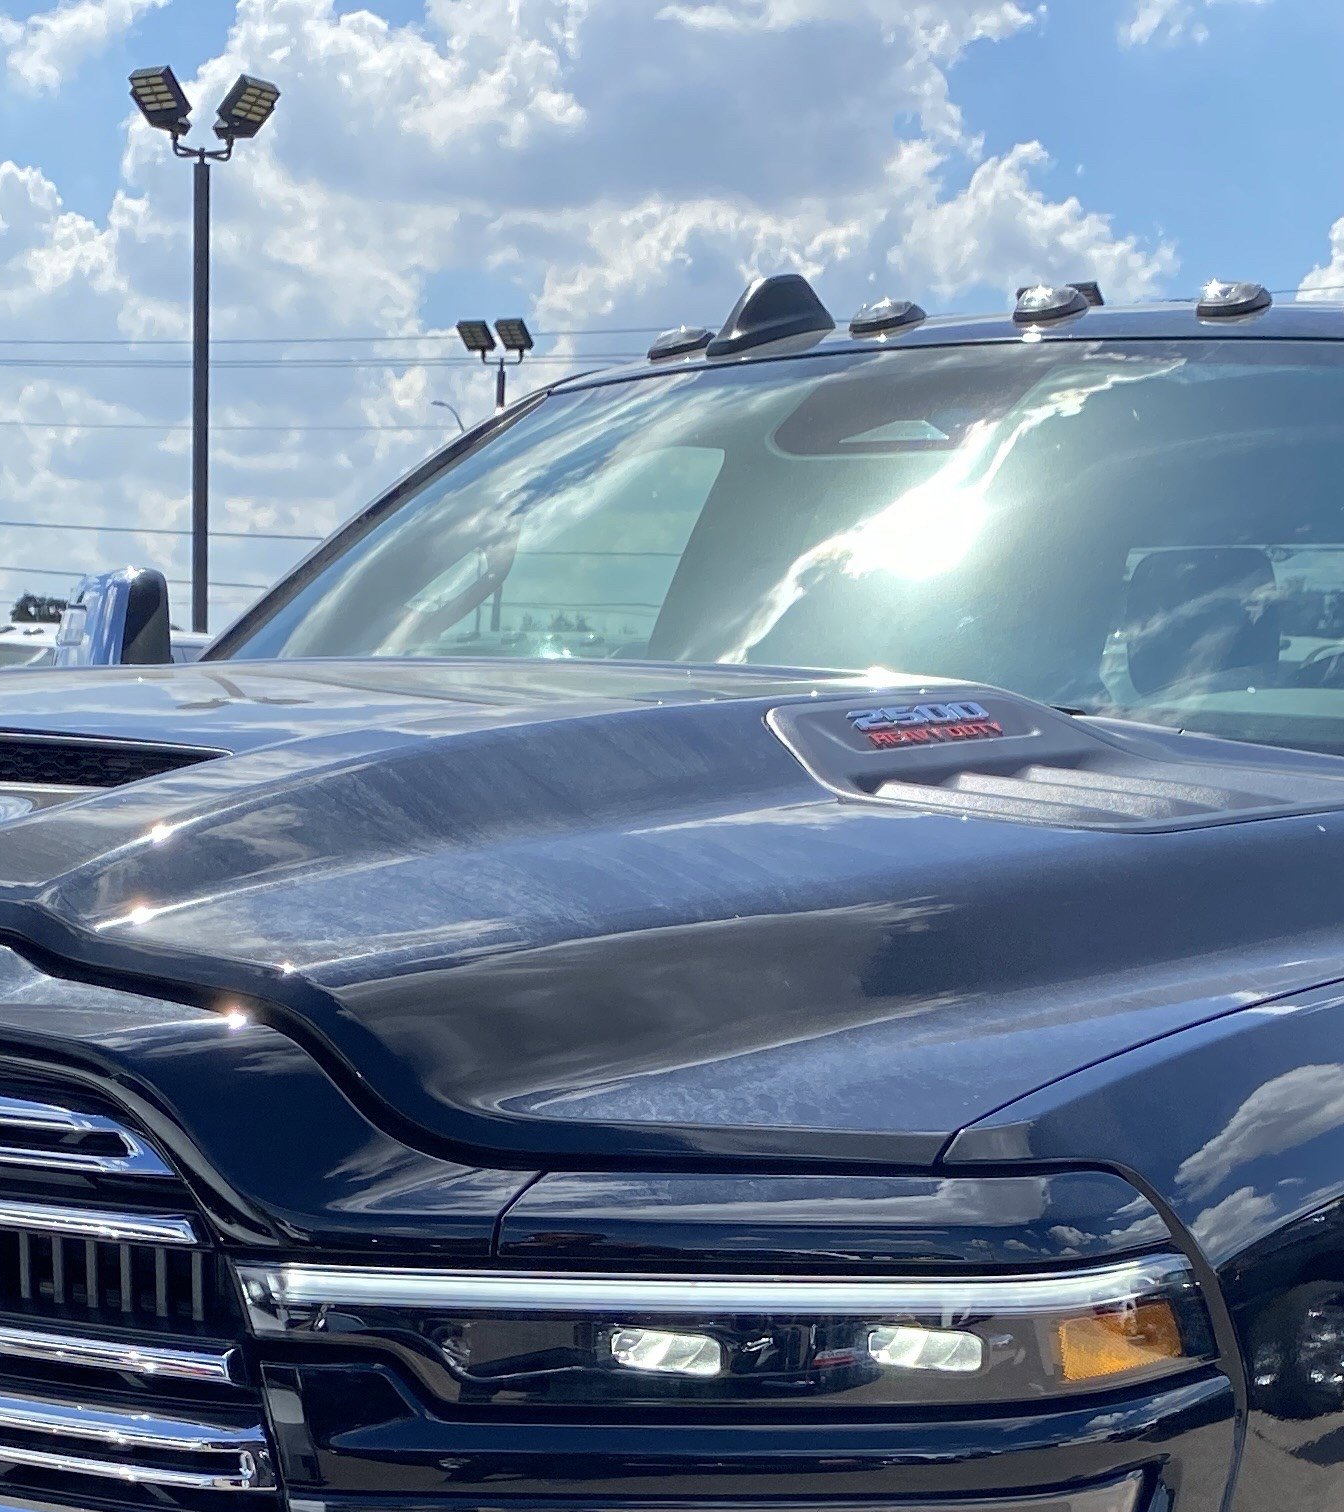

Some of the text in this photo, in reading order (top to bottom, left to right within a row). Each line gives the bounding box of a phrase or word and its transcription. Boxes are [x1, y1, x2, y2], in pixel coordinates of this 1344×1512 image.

[846, 701, 990, 732] 2500
[868, 721, 1004, 749] HEAVY DUTY
